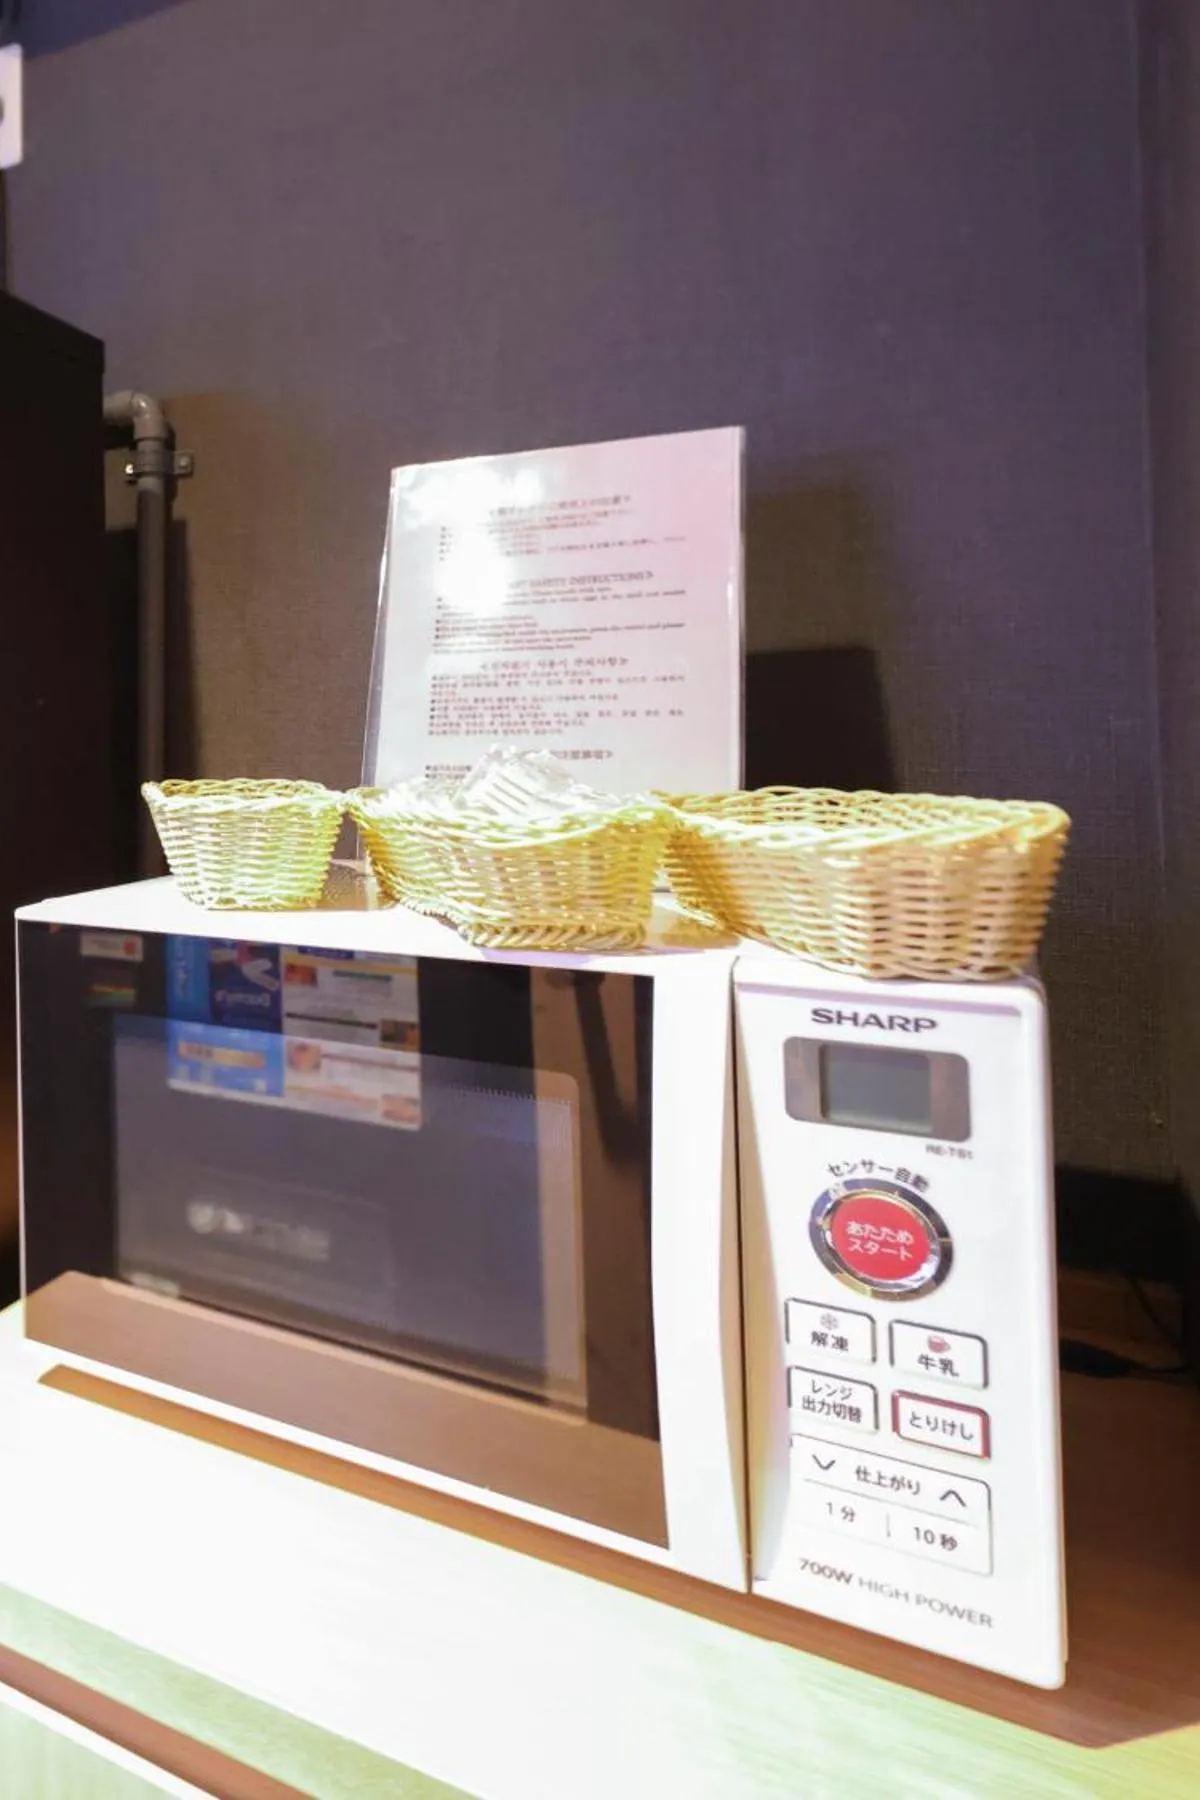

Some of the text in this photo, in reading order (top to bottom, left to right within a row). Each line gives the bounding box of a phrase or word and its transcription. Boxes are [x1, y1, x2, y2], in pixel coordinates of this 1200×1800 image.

[811, 1008, 938, 1033] SHARP
[827, 1159, 931, 1193] センサー自動
[847, 1220, 915, 1246] あたため
[847, 1238, 913, 1262] スタート
[811, 1330, 850, 1353] 解凍
[918, 1353, 960, 1378] 牛乳
[811, 1379, 854, 1401] レンジ
[801, 1396, 862, 1424] 出力切替
[909, 1411, 975, 1441] とりけし
[855, 1465, 921, 1496] 仕上がり
[799, 1557, 994, 1629] 700W HIGH POWER
